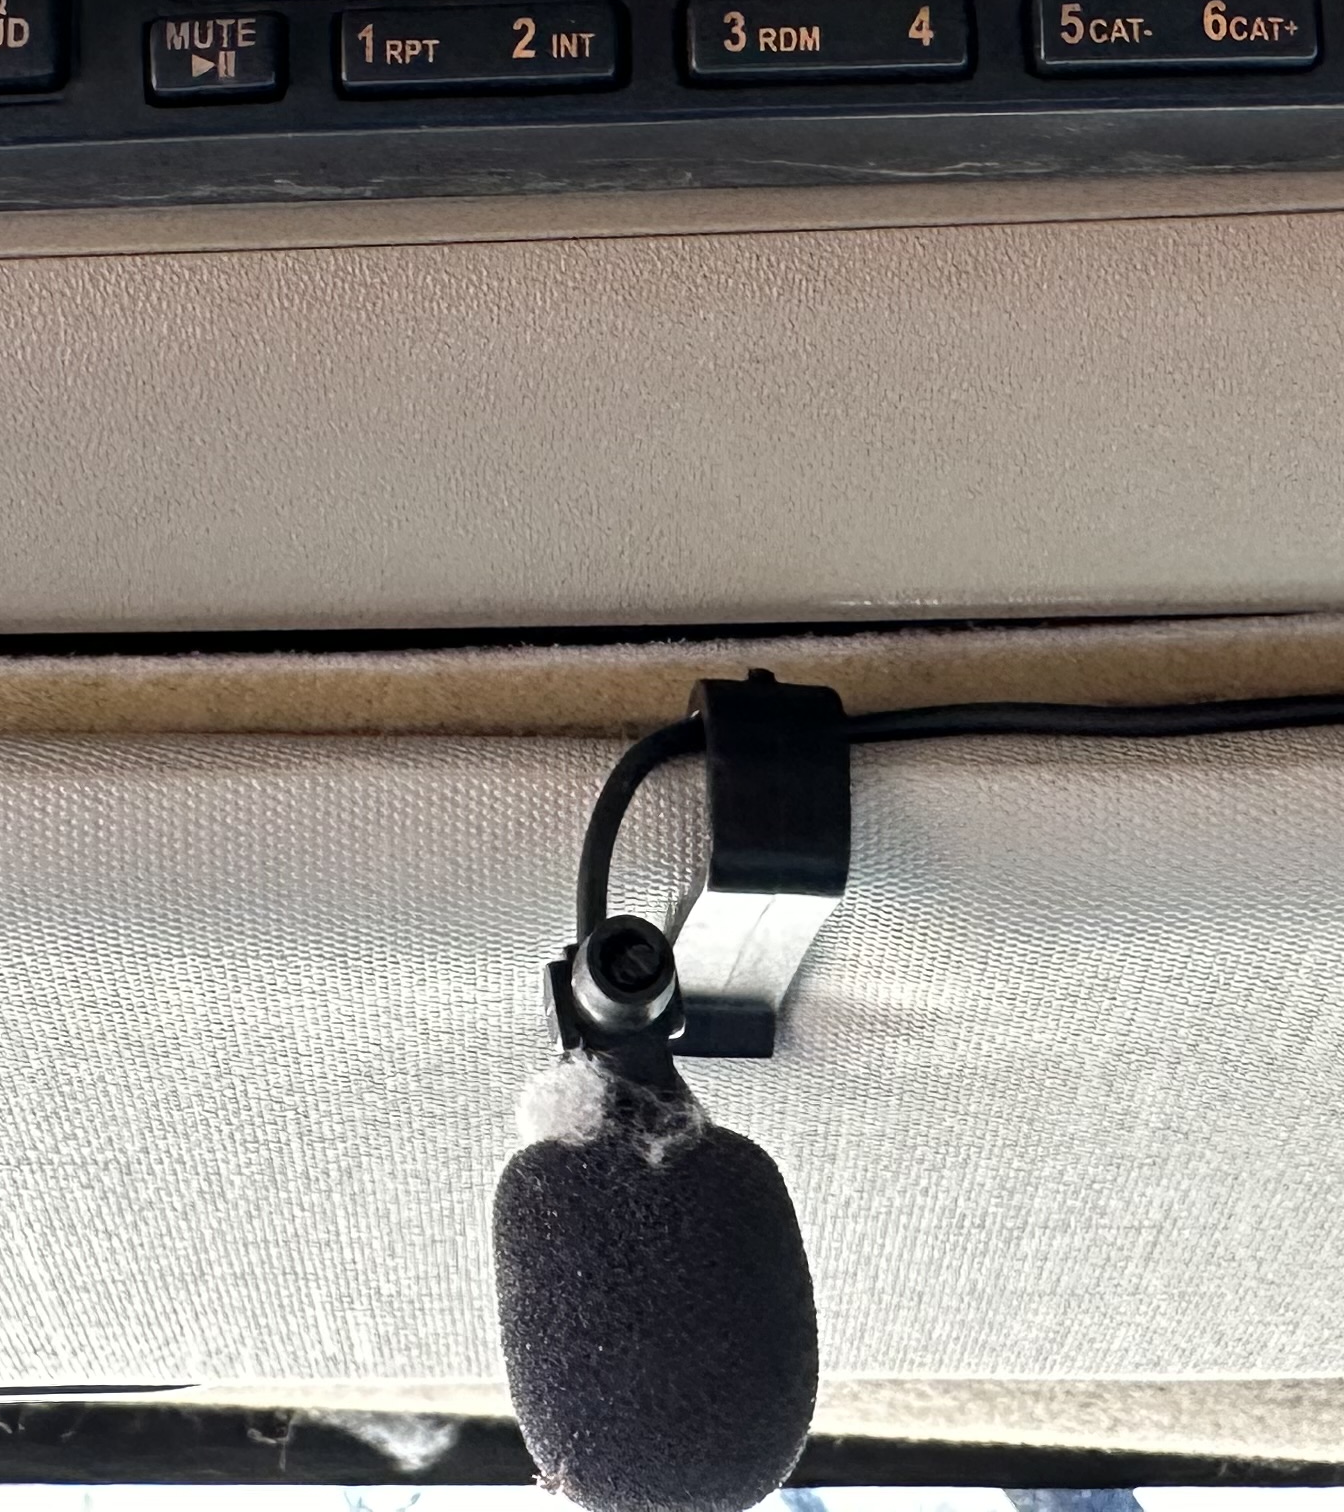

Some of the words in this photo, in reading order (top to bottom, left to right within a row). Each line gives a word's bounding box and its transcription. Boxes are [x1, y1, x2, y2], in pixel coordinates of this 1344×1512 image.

[165, 17, 257, 51] MUTE
[356, 22, 376, 64] 1
[384, 39, 441, 65] RPT
[512, 17, 537, 60] 2
[551, 31, 597, 60] INT
[722, 10, 748, 53] 3
[758, 25, 821, 52] RDM
[907, 5, 935, 48] 4
